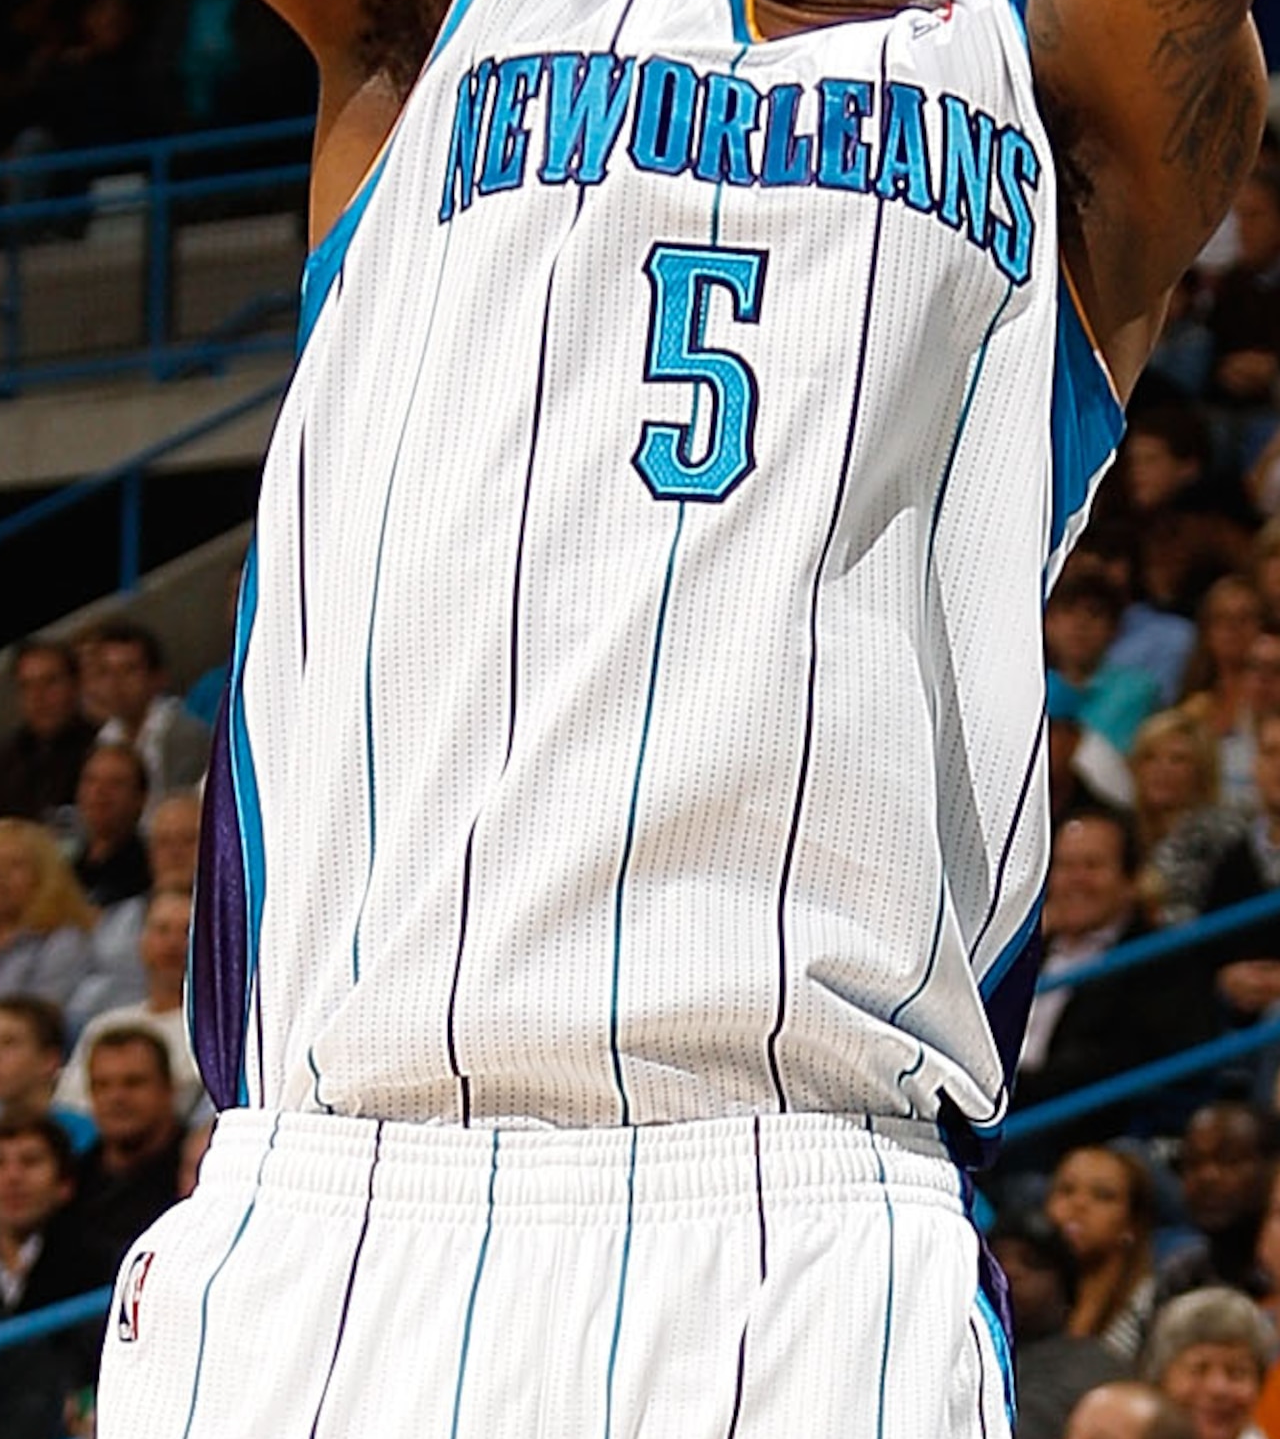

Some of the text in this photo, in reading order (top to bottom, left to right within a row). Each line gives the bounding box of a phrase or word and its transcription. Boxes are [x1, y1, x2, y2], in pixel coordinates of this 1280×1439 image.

[437, 49, 1044, 288] NEW ORLEANS
[632, 241, 769, 504] 5
